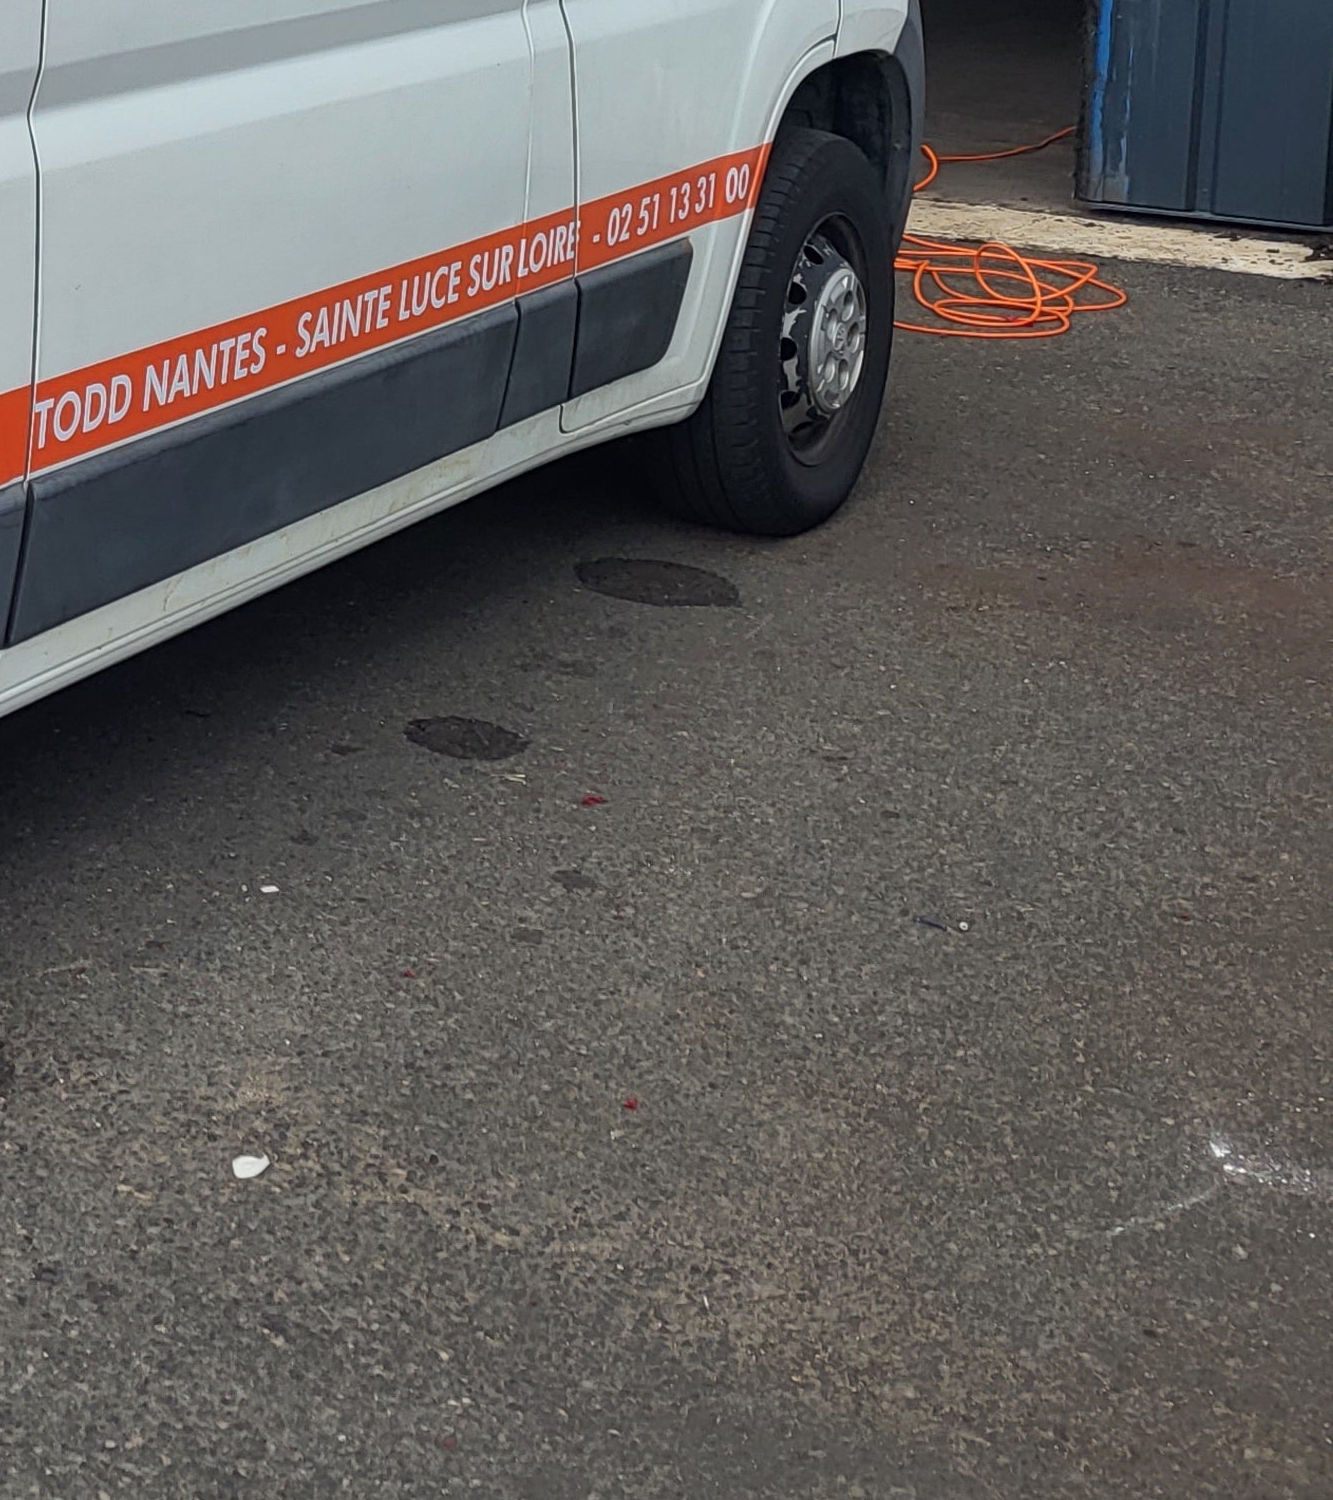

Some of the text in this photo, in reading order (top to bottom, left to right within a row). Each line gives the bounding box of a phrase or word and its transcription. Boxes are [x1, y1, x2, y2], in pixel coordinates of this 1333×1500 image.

[35, 374, 132, 449] TODD
[142, 327, 267, 412] NANTES
[295, 284, 392, 358] SAINTE
[399, 260, 462, 324] LUCE
[467, 243, 514, 298] SUR
[517, 220, 581, 277] LOIRE
[606, 203, 632, 246] 02
[637, 193, 661, 235] 51
[669, 182, 691, 223] 13
[695, 173, 716, 215] 31
[725, 163, 750, 204] 00
